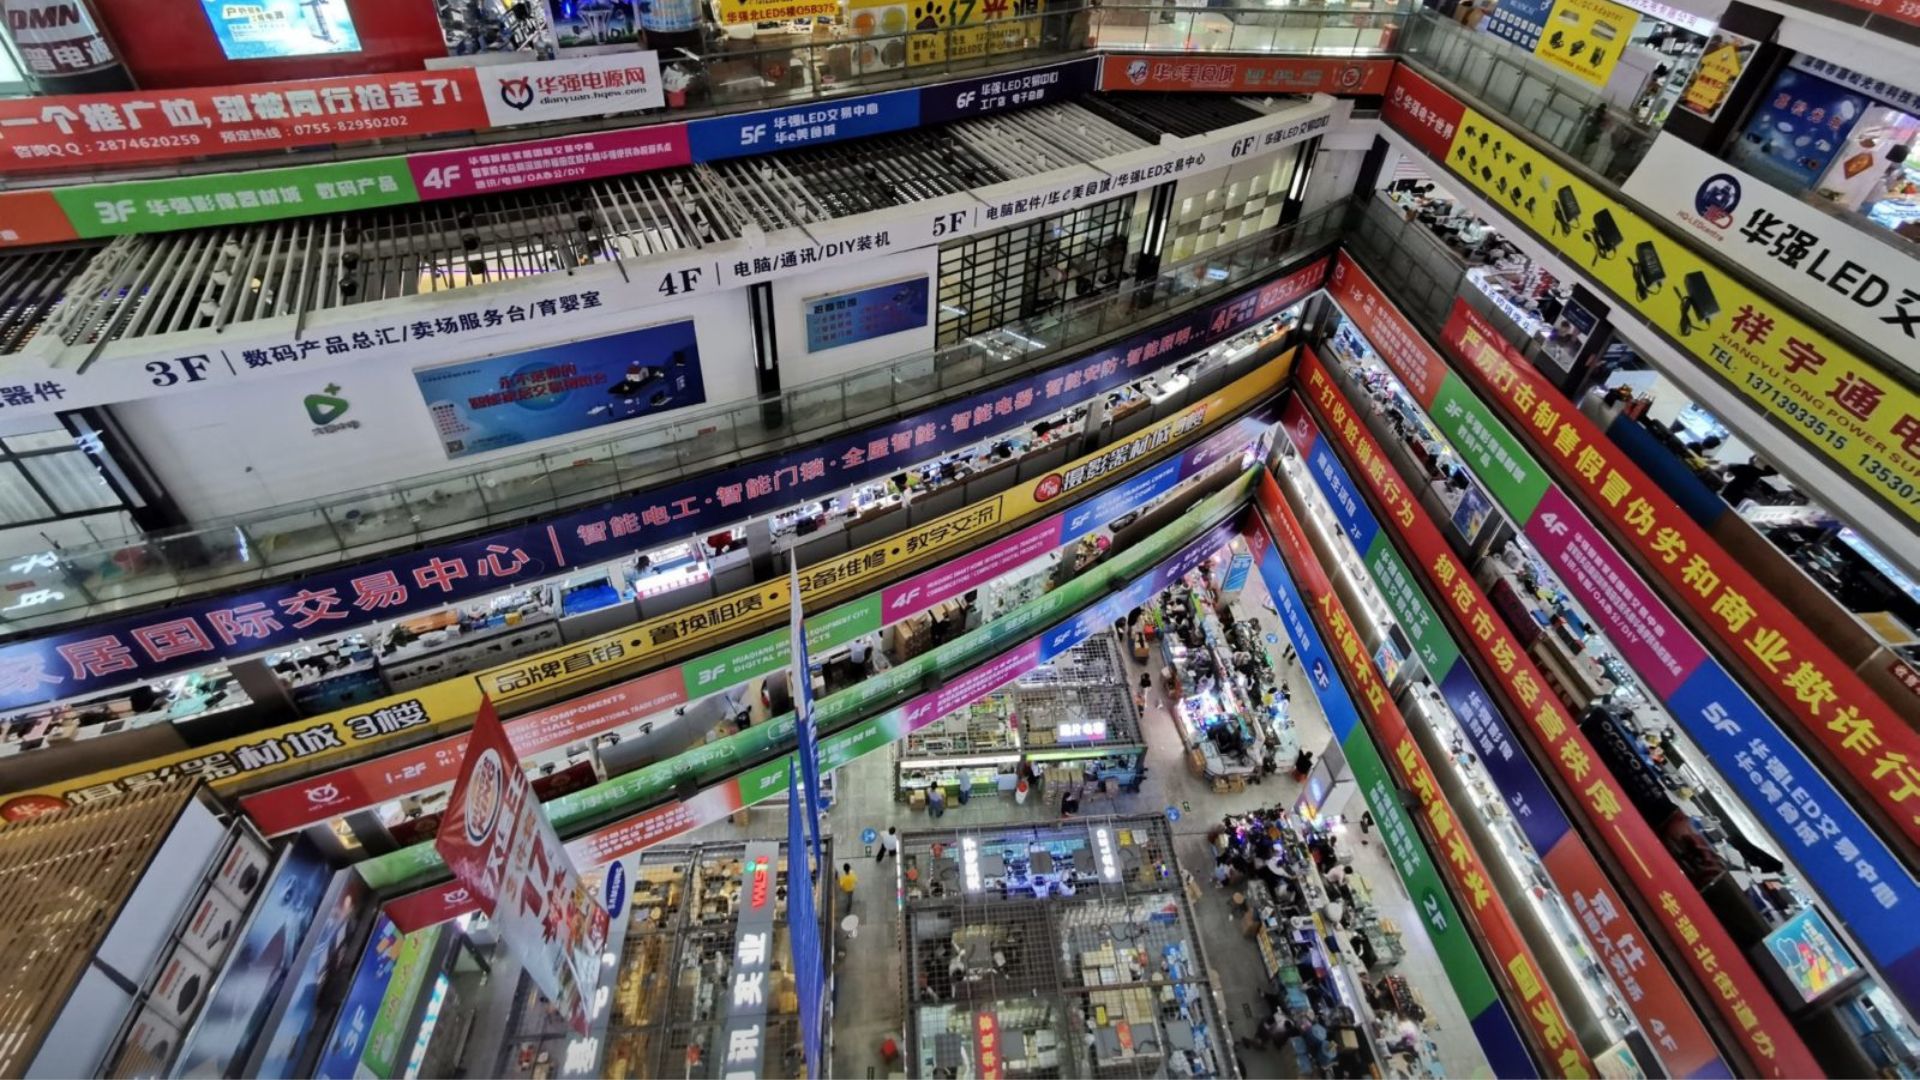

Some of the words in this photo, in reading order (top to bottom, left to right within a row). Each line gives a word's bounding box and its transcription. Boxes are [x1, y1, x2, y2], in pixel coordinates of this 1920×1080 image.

[536, 66, 645, 95] 华强电源网
[539, 86, 648, 106] dianyuan.hqew.com
[980, 72, 1060, 97] 华强LED交易中心
[774, 103, 878, 130] 华强LED交易中心
[956, 91, 976, 110] 6F
[1402, 90, 1454, 140] 华强电子世界
[740, 125, 766, 146] 5F
[775, 124, 836, 144] 华e美食城
[1231, 134, 1255, 158] 6F
[1264, 115, 1330, 145] 华强LED交易中心
[423, 165, 461, 190] 4F
[475, 167, 586, 190] 通讯/电脑/OA办公/DIY
[986, 153, 1206, 220] 电脑配件/华e美食城/华强LED交易中心
[94, 198, 136, 225] 3F
[147, 186, 302, 217] 华强影像器材城
[315, 175, 398, 200] 数码产品
[932, 210, 967, 236] 5F
[734, 231, 890, 277] 电脑/通讯/DIY装机
[658, 266, 702, 297] 4F
[243, 290, 604, 369] 数码产品总汇/卖场服务台/育婴室
[1210, 306, 1239, 334] 4F
[146, 353, 212, 387] 3F
[1044, 354, 1121, 400] 智能安防
[0, 380, 67, 406] 器件
[1445, 398, 1461, 419] 3F
[1708, 344, 1738, 375] TEL:
[1744, 371, 1848, 451] 13713933515
[1717, 331, 1781, 379] XIANGYU
[1780, 375, 1825, 410] TONG
[1826, 408, 1886, 454] POWER
[951, 389, 1033, 431] 智能电器
[842, 420, 937, 470] 全屋智能
[1062, 423, 1172, 494] 摄影器材城
[716, 457, 825, 505] 智能门锁
[578, 495, 700, 545] 智能电工
[905, 503, 996, 553] 教学交流
[1067, 510, 1093, 531] 5F
[1350, 525, 1363, 542] 2F
[1539, 511, 1568, 537] 4F
[787, 547, 887, 598] 设备维修
[1457, 326, 1920, 826] 严厉打击制售假冒伪劣和商业欺诈行
[852, 608, 869, 619] CITY
[889, 586, 923, 610] 4F
[0, 543, 530, 696] 家居国际交易中心
[649, 594, 764, 647] 置换租赁
[496, 640, 623, 695] 品牌直销
[732, 652, 774, 673] DIGITAL
[775, 631, 831, 658] PRUCTS
[1318, 592, 1388, 715] 人无信不立
[1422, 644, 1439, 665] 2F
[698, 664, 727, 686] 3F
[1313, 663, 1330, 690] 2F
[345, 699, 427, 741] 3楼
[540, 692, 627, 725] COMPONENTS
[629, 700, 652, 713] TRADE
[906, 703, 932, 722] 4F
[1309, 367, 1415, 528] 严打收赃销赃行为
[1432, 553, 1623, 821] 规范市场经营秩序
[1658, 889, 1777, 1060] 华强北街道办
[1701, 702, 1742, 737] 5F
[385, 763, 427, 785] 1-2F
[759, 770, 784, 789] 3F
[1511, 792, 1533, 819] 3F
[1734, 751, 1821, 848] 华e美食城
[1749, 738, 1899, 910] 华强LED交易中心
[608, 866, 622, 911] SAMSUNG
[1422, 898, 1448, 931] 2F
[1571, 890, 1645, 1002] 电脑大卖场
[1650, 1017, 1679, 1052] 4F
